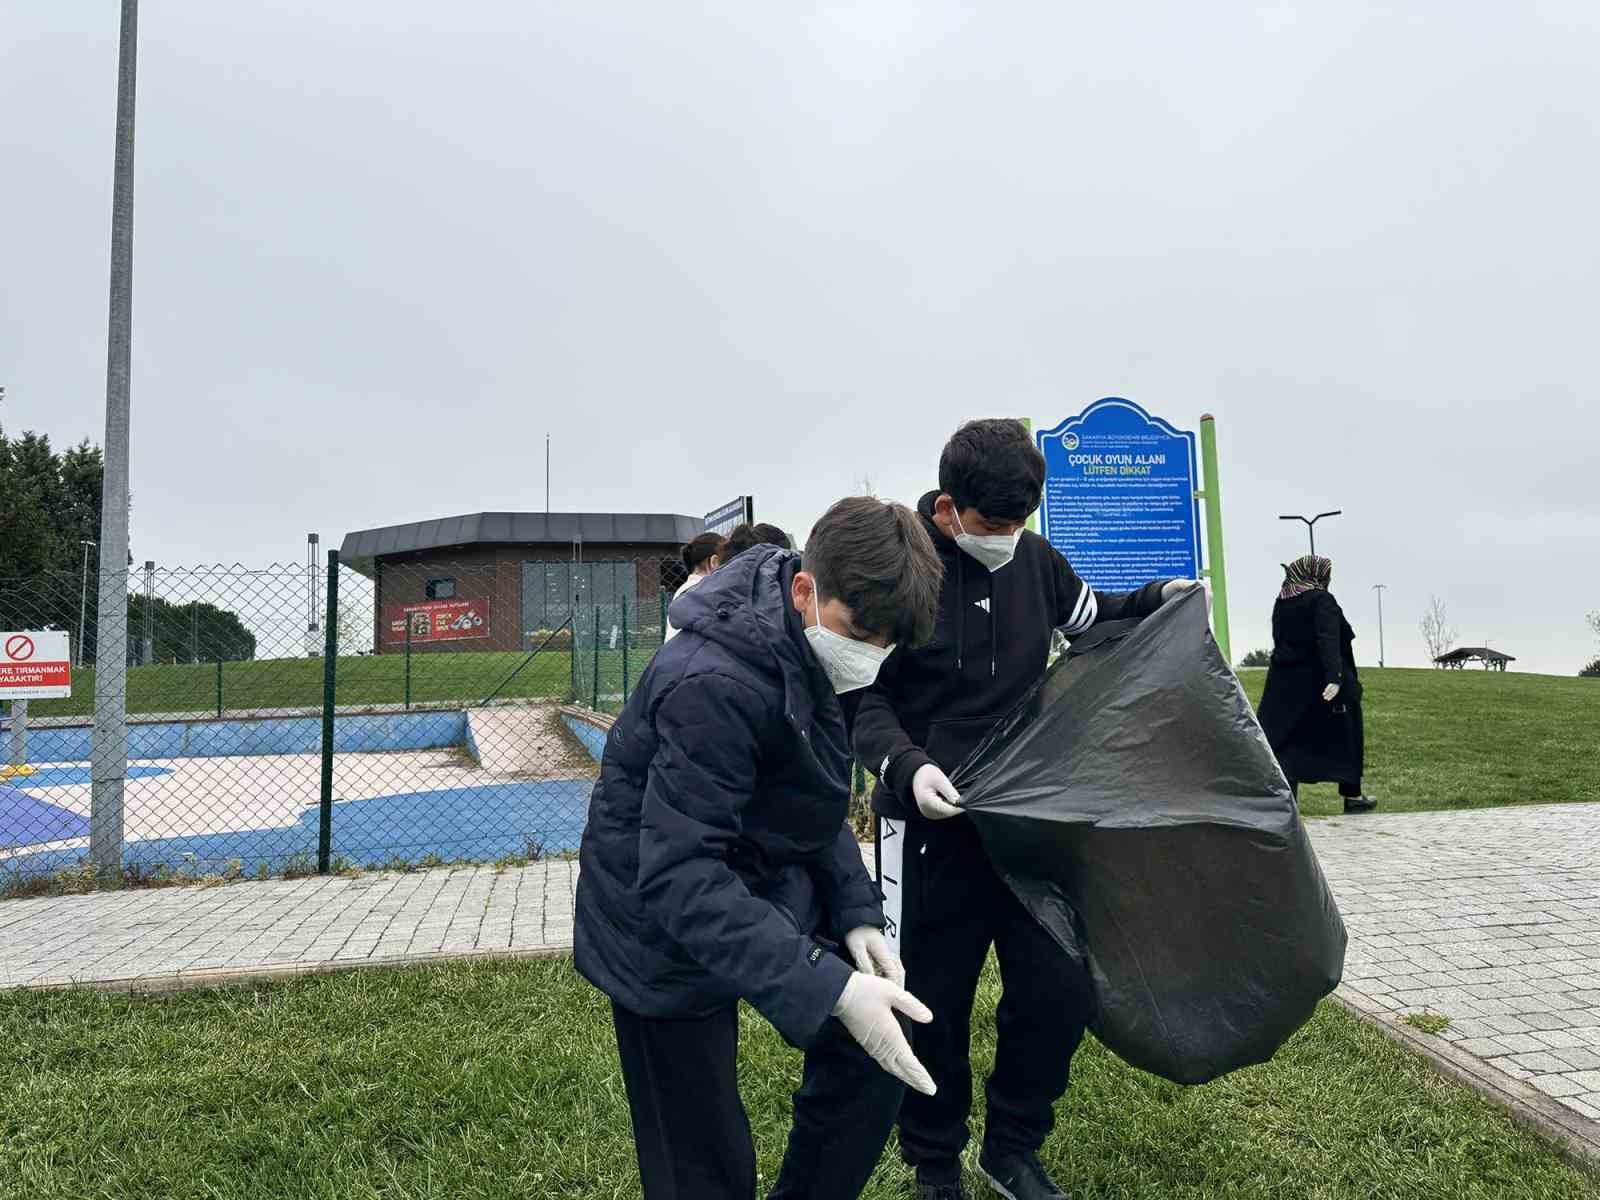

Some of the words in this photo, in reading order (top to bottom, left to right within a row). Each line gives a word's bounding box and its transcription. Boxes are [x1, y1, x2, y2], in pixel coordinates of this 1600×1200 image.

[1068, 454, 1103, 466] ÇOCUK
[1105, 454, 1132, 465] OYUN
[1135, 453, 1166, 464] ALANI
[1083, 465, 1117, 475] LÜTFEN
[1119, 465, 1152, 475] DİKKAT
[16, 666, 65, 674] TIRMANMAK
